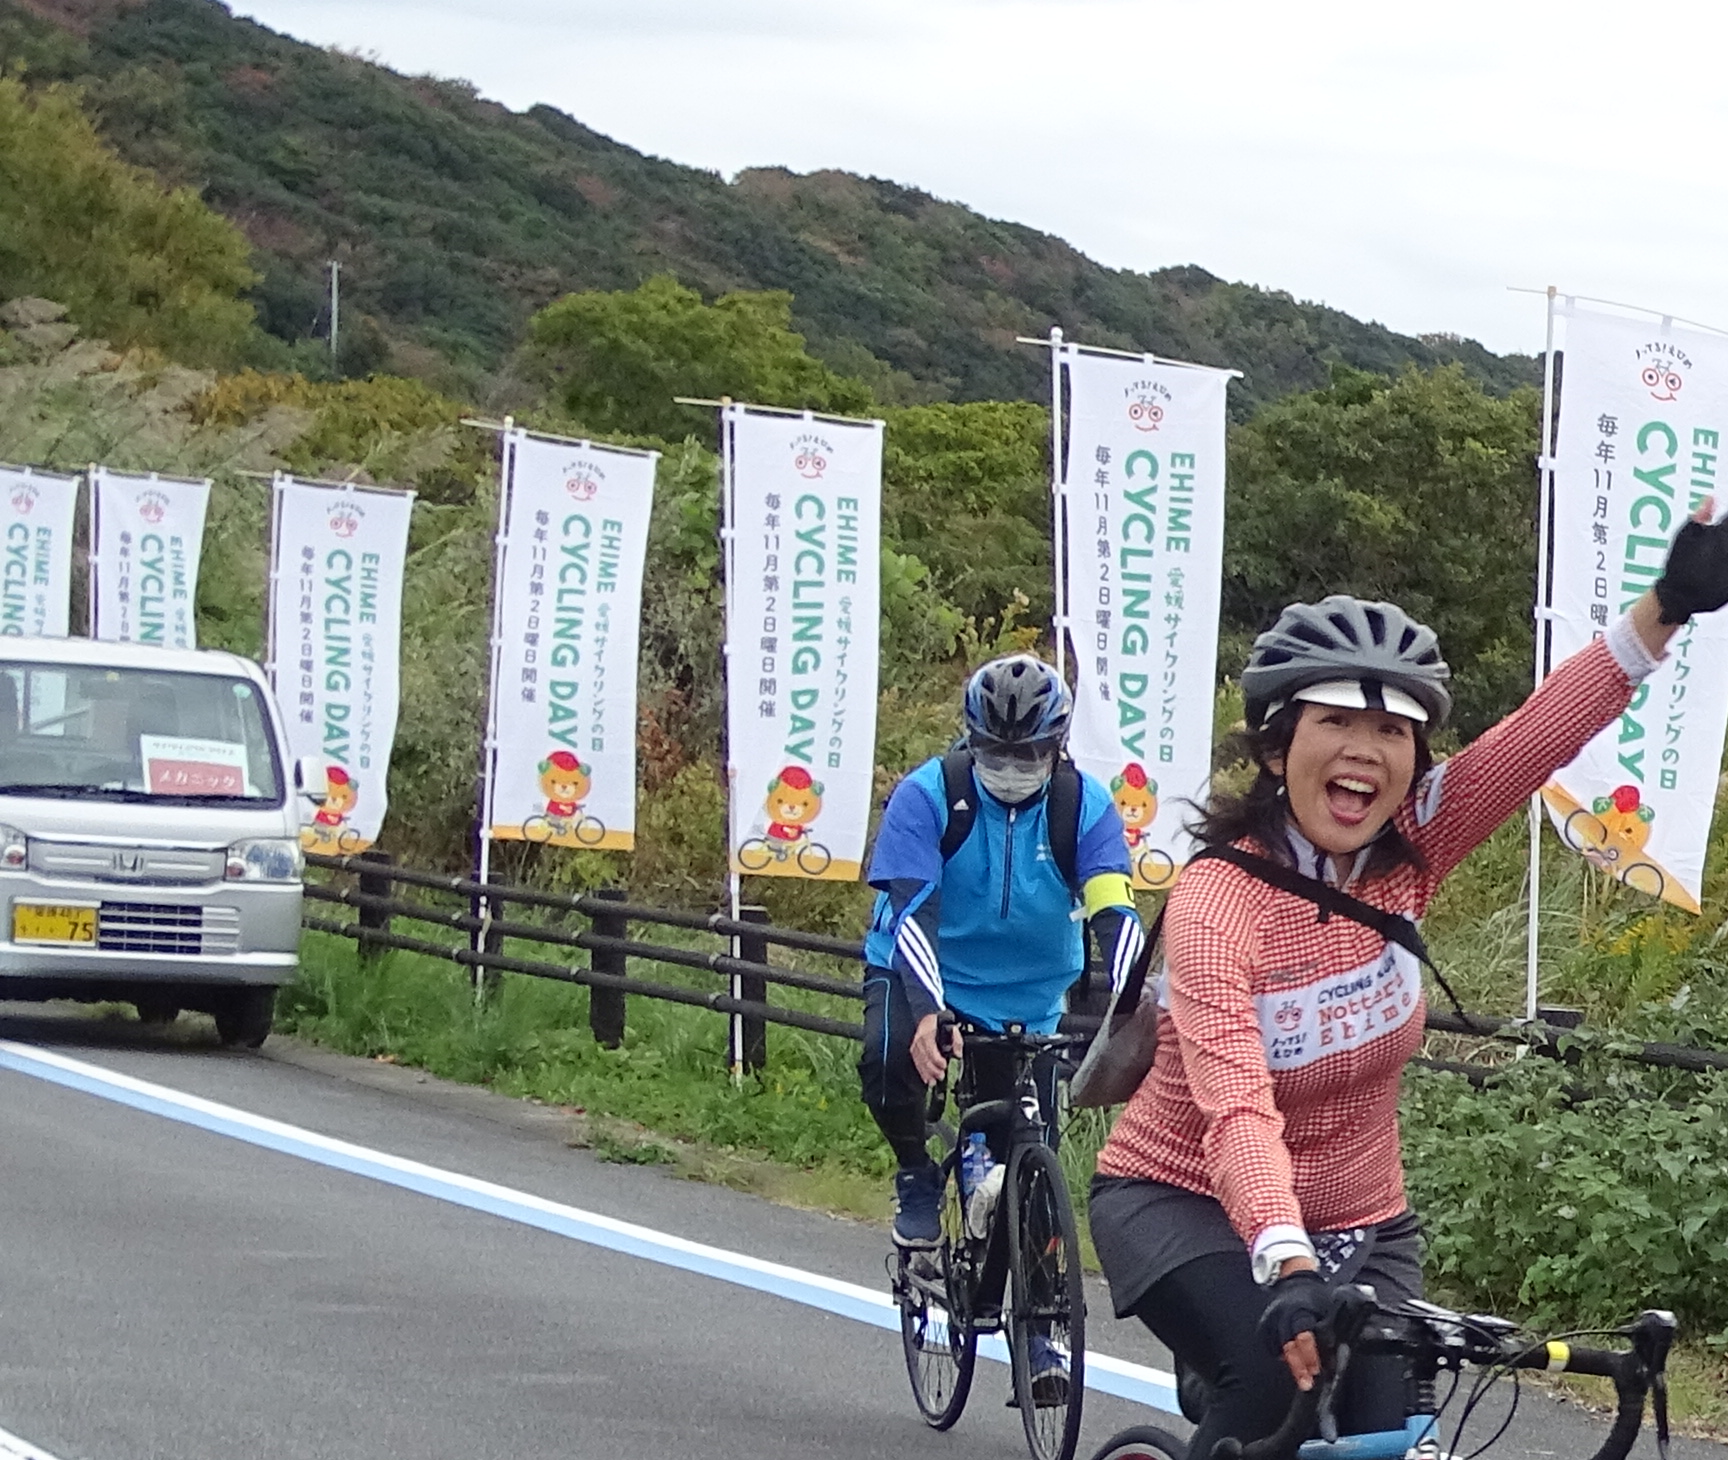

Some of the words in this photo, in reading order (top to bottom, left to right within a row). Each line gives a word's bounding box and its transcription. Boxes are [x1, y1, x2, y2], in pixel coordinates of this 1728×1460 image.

[836, 496, 859, 585] EHIME
[1166, 452, 1196, 554] EHIME
[170, 535, 187, 600] EHIME
[359, 552, 381, 625] EHIME
[551, 513, 593, 668] CYCLING
[596, 518, 623, 594] EHIME
[791, 493, 827, 676] CYCLING
[1094, 445, 1112, 702] 毎年11月第2日曜日開催
[1120, 449, 1160, 657] CYCLING
[323, 548, 353, 693] CYCLING
[758, 492, 782, 719] 毎年11月第2日曜日開催
[1159, 567, 1185, 763] 愛媛サイクリングの日
[322, 702, 351, 765] DAY
[548, 679, 579, 749] DAY
[784, 688, 820, 765] DAY
[1117, 672, 1149, 760] DAY
[68, 921, 94, 942] 75
[1317, 974, 1373, 1005] CYCLING
[1320, 992, 1412, 1047] Ehime
